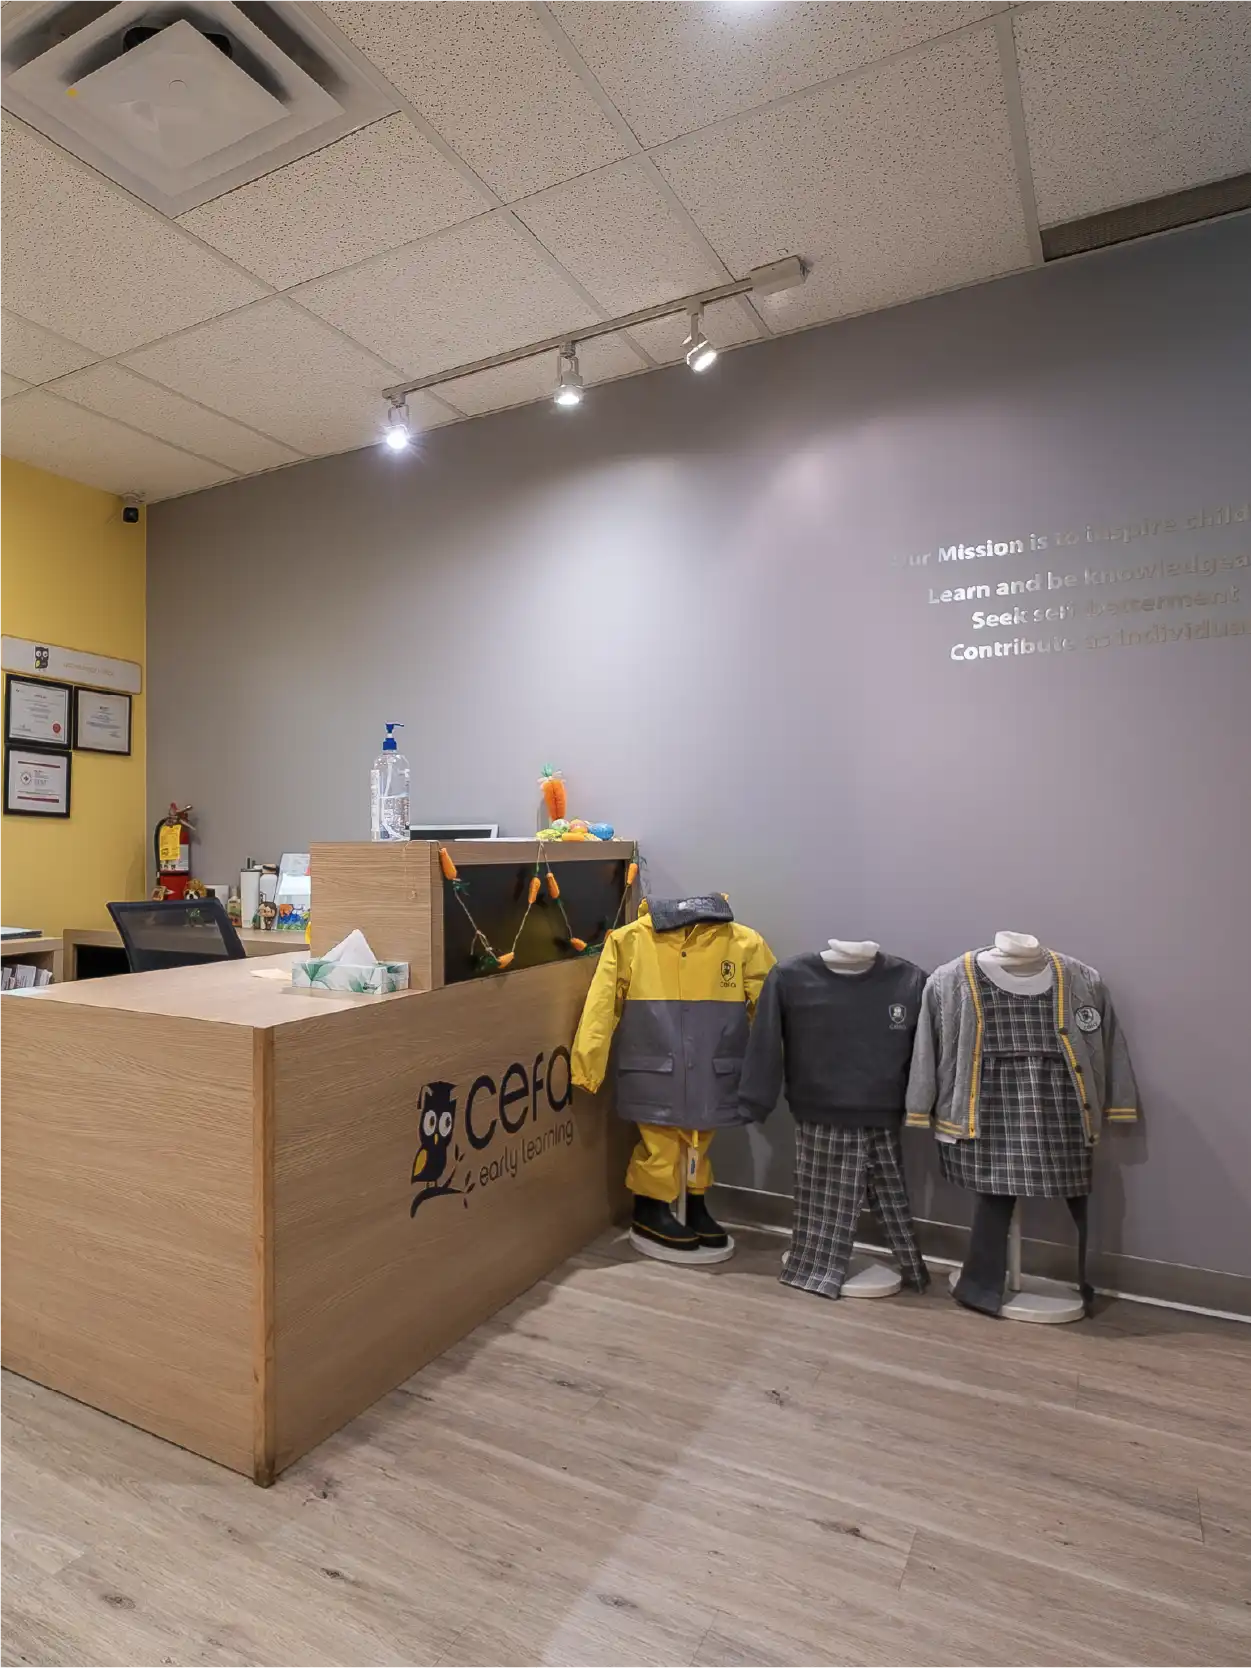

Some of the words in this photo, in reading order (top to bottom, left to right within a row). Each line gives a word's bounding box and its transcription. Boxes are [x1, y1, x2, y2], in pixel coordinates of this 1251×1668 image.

[937, 539, 1025, 563] Mission
[1029, 532, 1049, 551] is
[927, 584, 991, 605] Learn
[995, 573, 1042, 596] and
[1047, 571, 1078, 591] be
[970, 606, 1029, 631] Seek
[464, 1045, 573, 1150] cefa
[479, 1146, 519, 1188] early
[521, 1119, 574, 1165] learning
